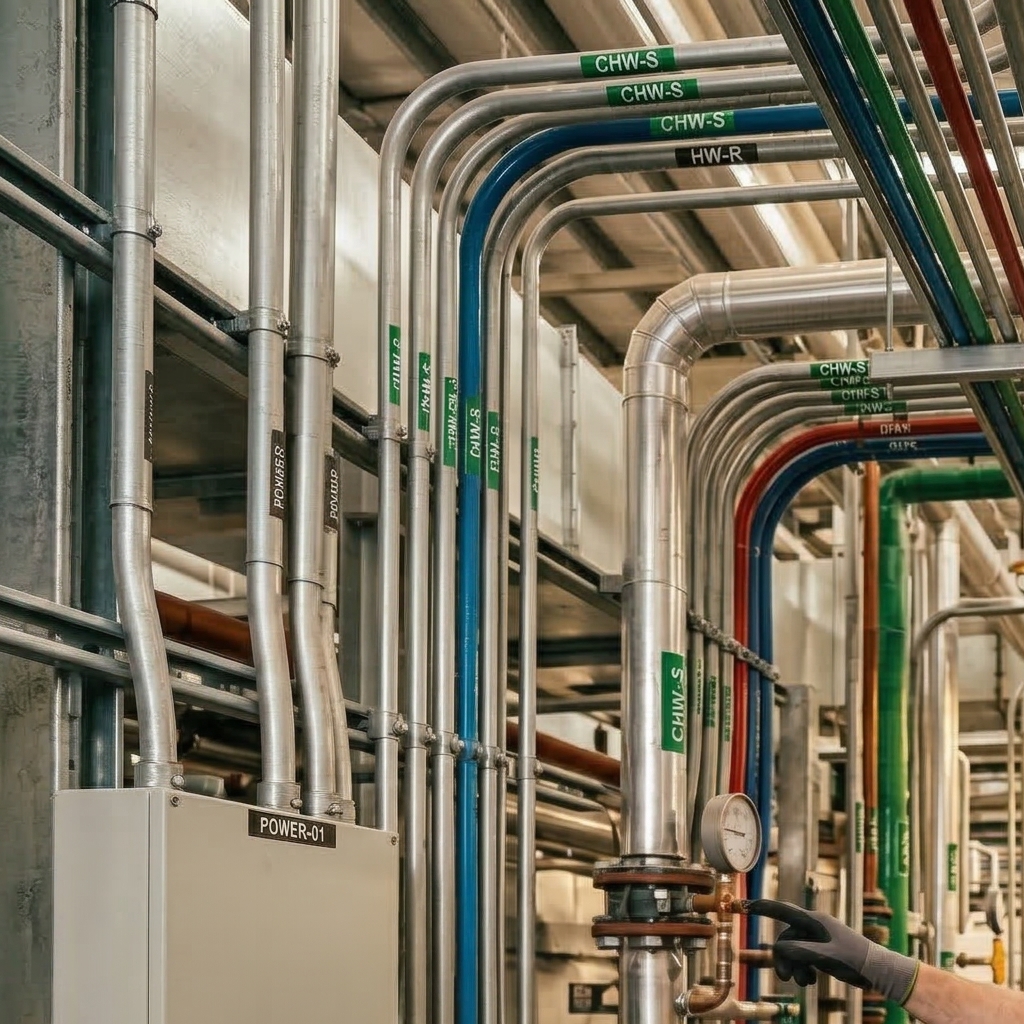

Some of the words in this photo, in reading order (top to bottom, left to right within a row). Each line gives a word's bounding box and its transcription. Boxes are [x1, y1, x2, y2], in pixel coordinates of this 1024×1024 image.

[595, 51, 659, 73] CHW-S
[621, 82, 683, 103] CHW-S
[661, 112, 725, 132] CHW-S
[691, 146, 743, 165] HW-R
[260, 816, 324, 842] POWER-01
